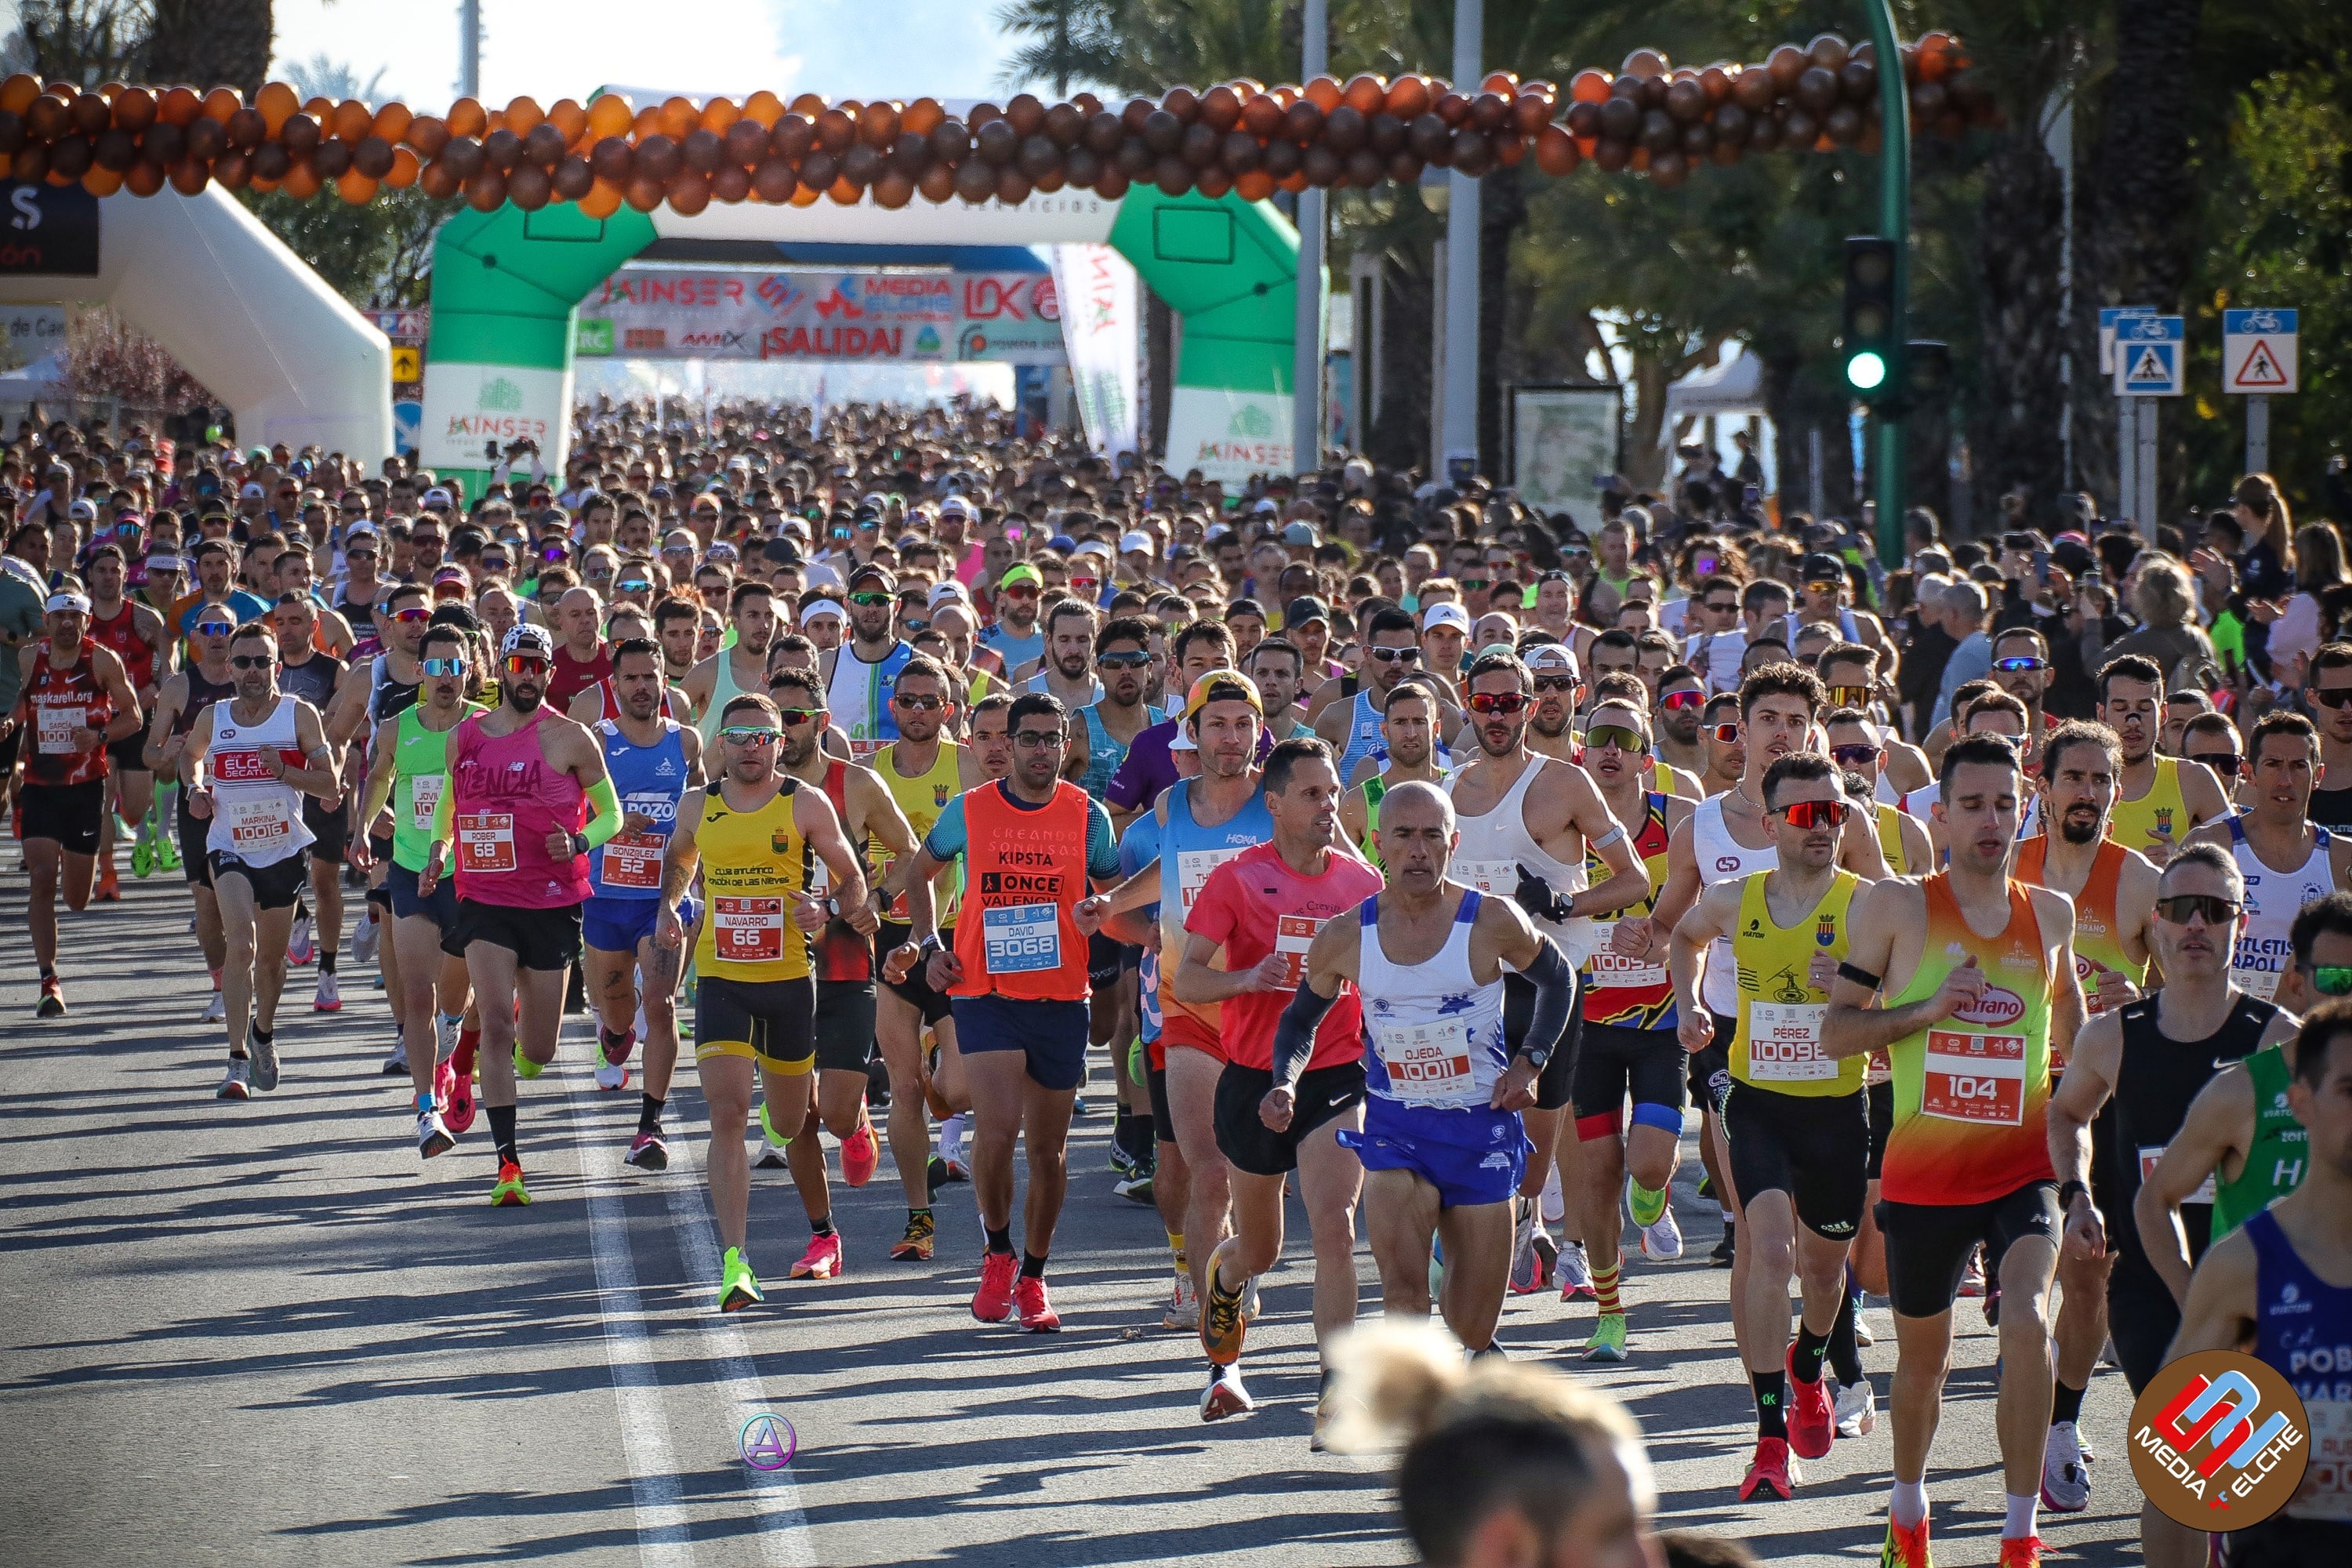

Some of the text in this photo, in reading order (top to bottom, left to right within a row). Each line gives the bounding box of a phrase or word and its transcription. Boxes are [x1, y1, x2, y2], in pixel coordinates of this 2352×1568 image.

[865, 278, 952, 296] MEDIA
[30, 690, 93, 705] maskarell.org
[49, 720, 72, 731] GARCÍA
[42, 731, 75, 742] 1001
[241, 815, 278, 826] MARKINA
[238, 823, 283, 840] 10016
[471, 831, 496, 841] ROBER
[991, 827, 1079, 842] CREANDO
[1225, 833, 1258, 845] HOKA
[474, 843, 496, 858] 68
[612, 846, 655, 859] GONZ@LEZ
[987, 840, 1081, 857] SONRISAS
[619, 858, 645, 875] 52
[998, 851, 1054, 867] KIPSTA
[1004, 874, 1060, 893] ONCE
[1475, 881, 1490, 892] MB
[724, 916, 768, 927] NAVARRO
[732, 929, 760, 946] 66
[1008, 926, 1034, 938] DAVID
[1742, 931, 1766, 940] VIATOR
[989, 937, 1054, 957] 3068
[1773, 1025, 1810, 1040] PÉREZ
[1404, 1046, 1443, 1061] OJEDA
[1399, 1058, 1456, 1081] 10011
[1948, 1075, 1998, 1101] 104
[1820, 1223, 1855, 1233] adidas
